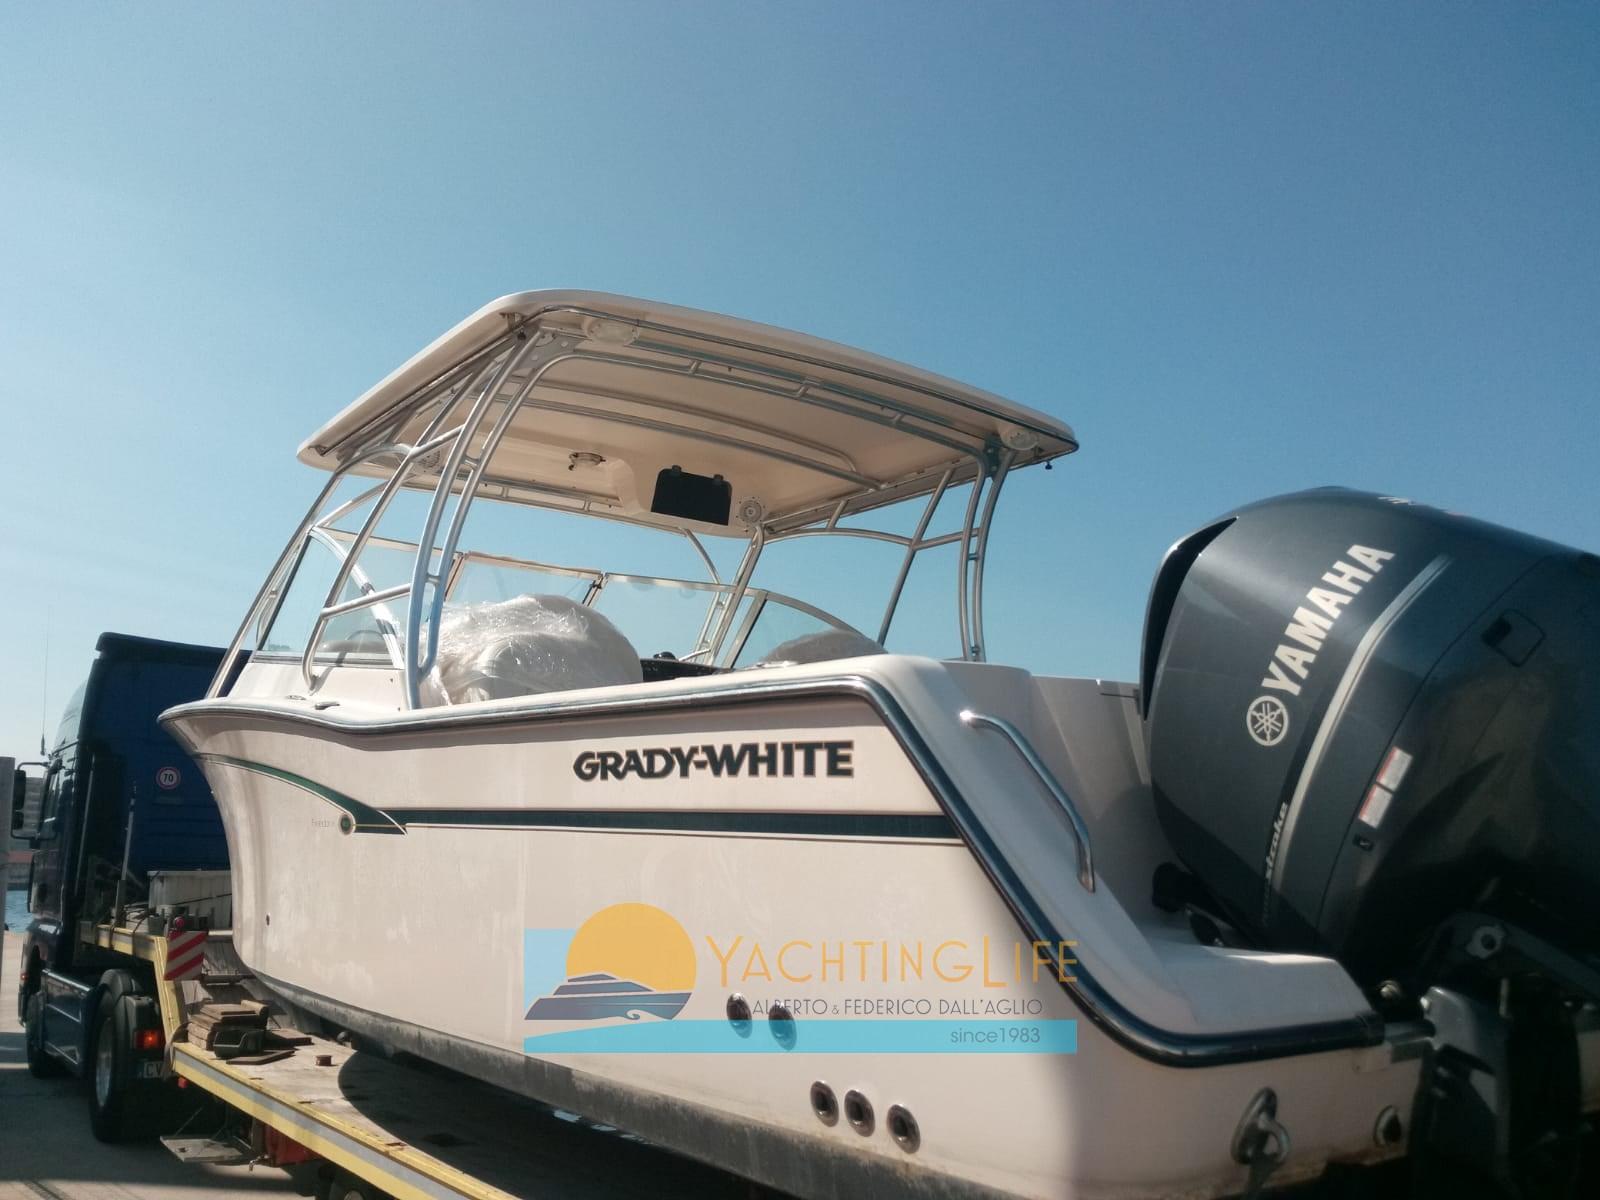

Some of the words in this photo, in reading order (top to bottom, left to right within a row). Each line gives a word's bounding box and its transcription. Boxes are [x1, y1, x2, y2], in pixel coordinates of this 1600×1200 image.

[1261, 544, 1395, 697] YAMAHA
[163, 773, 174, 783] 70
[573, 740, 854, 781] GRADY-WHITE
